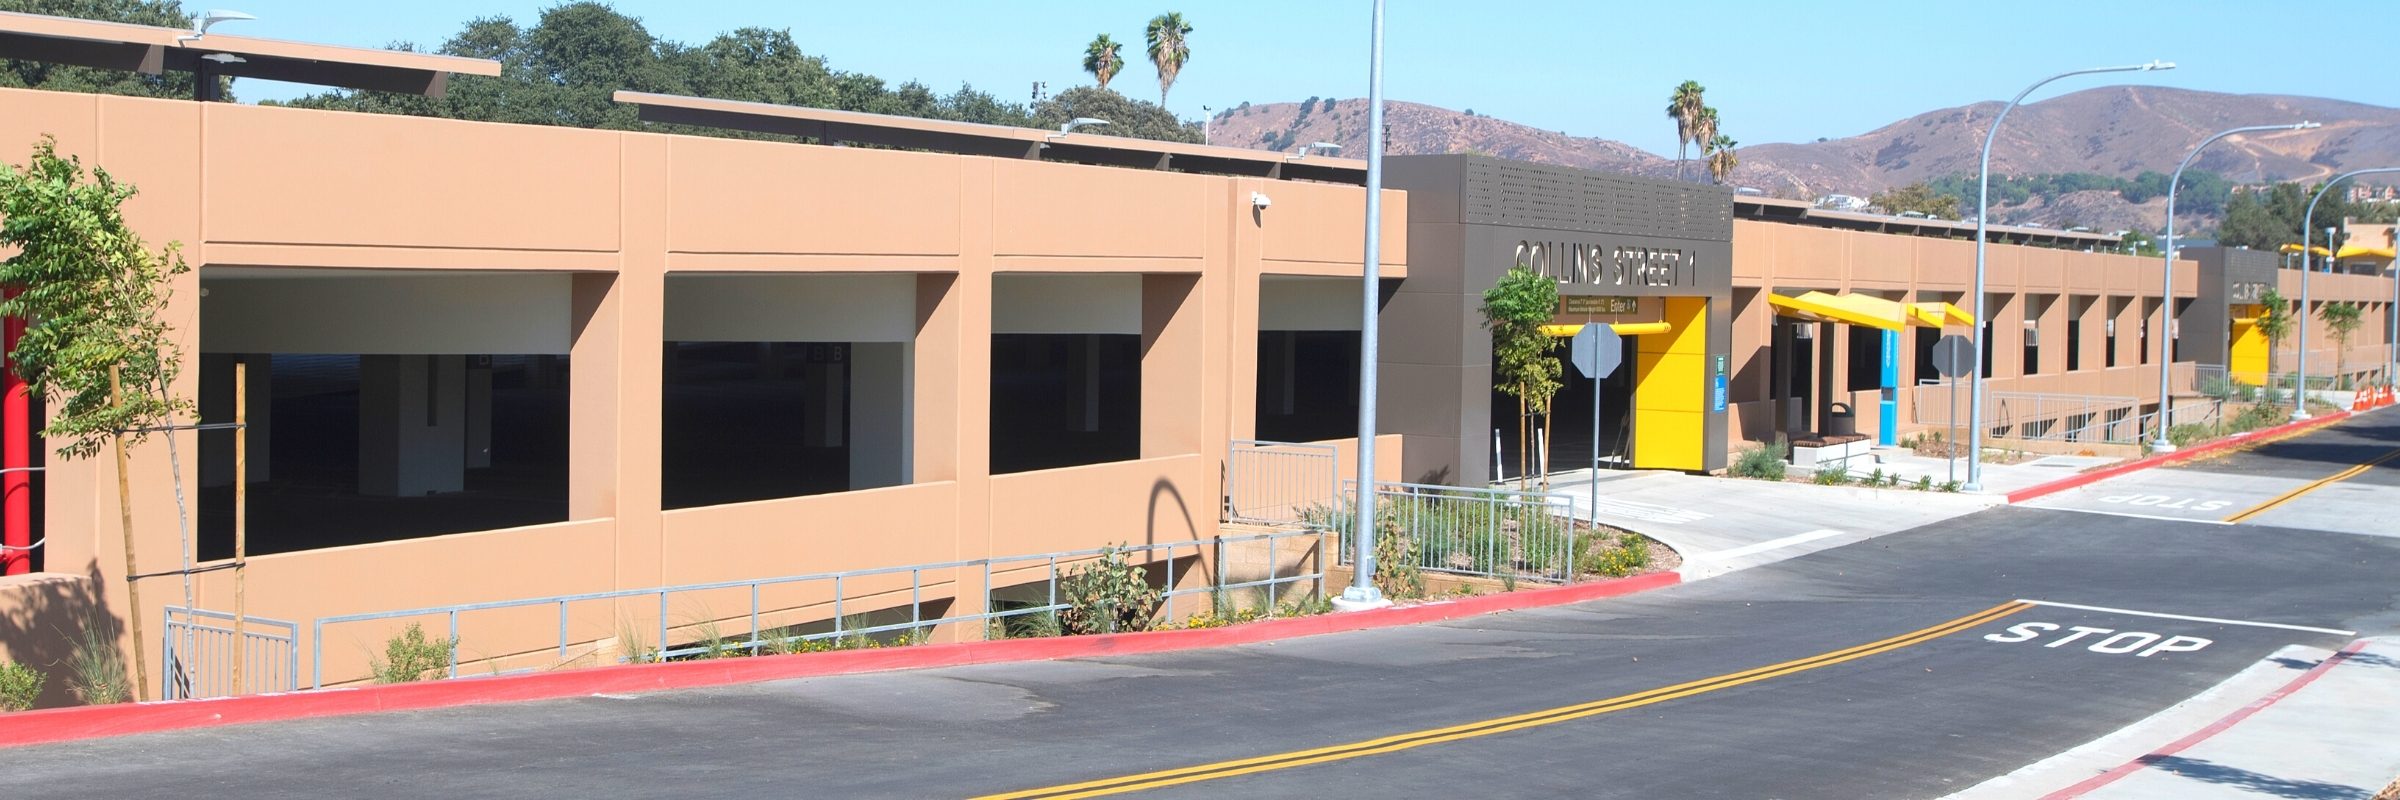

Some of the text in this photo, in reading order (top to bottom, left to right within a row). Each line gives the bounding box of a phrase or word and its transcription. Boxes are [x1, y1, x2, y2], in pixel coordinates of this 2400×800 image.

[1515, 240, 1696, 287] COLLINS STREET 1
[1610, 299, 1626, 313] Enter
[834, 346, 842, 361] B
[2098, 493, 2233, 511] STOP
[1983, 621, 2214, 658] STOP
